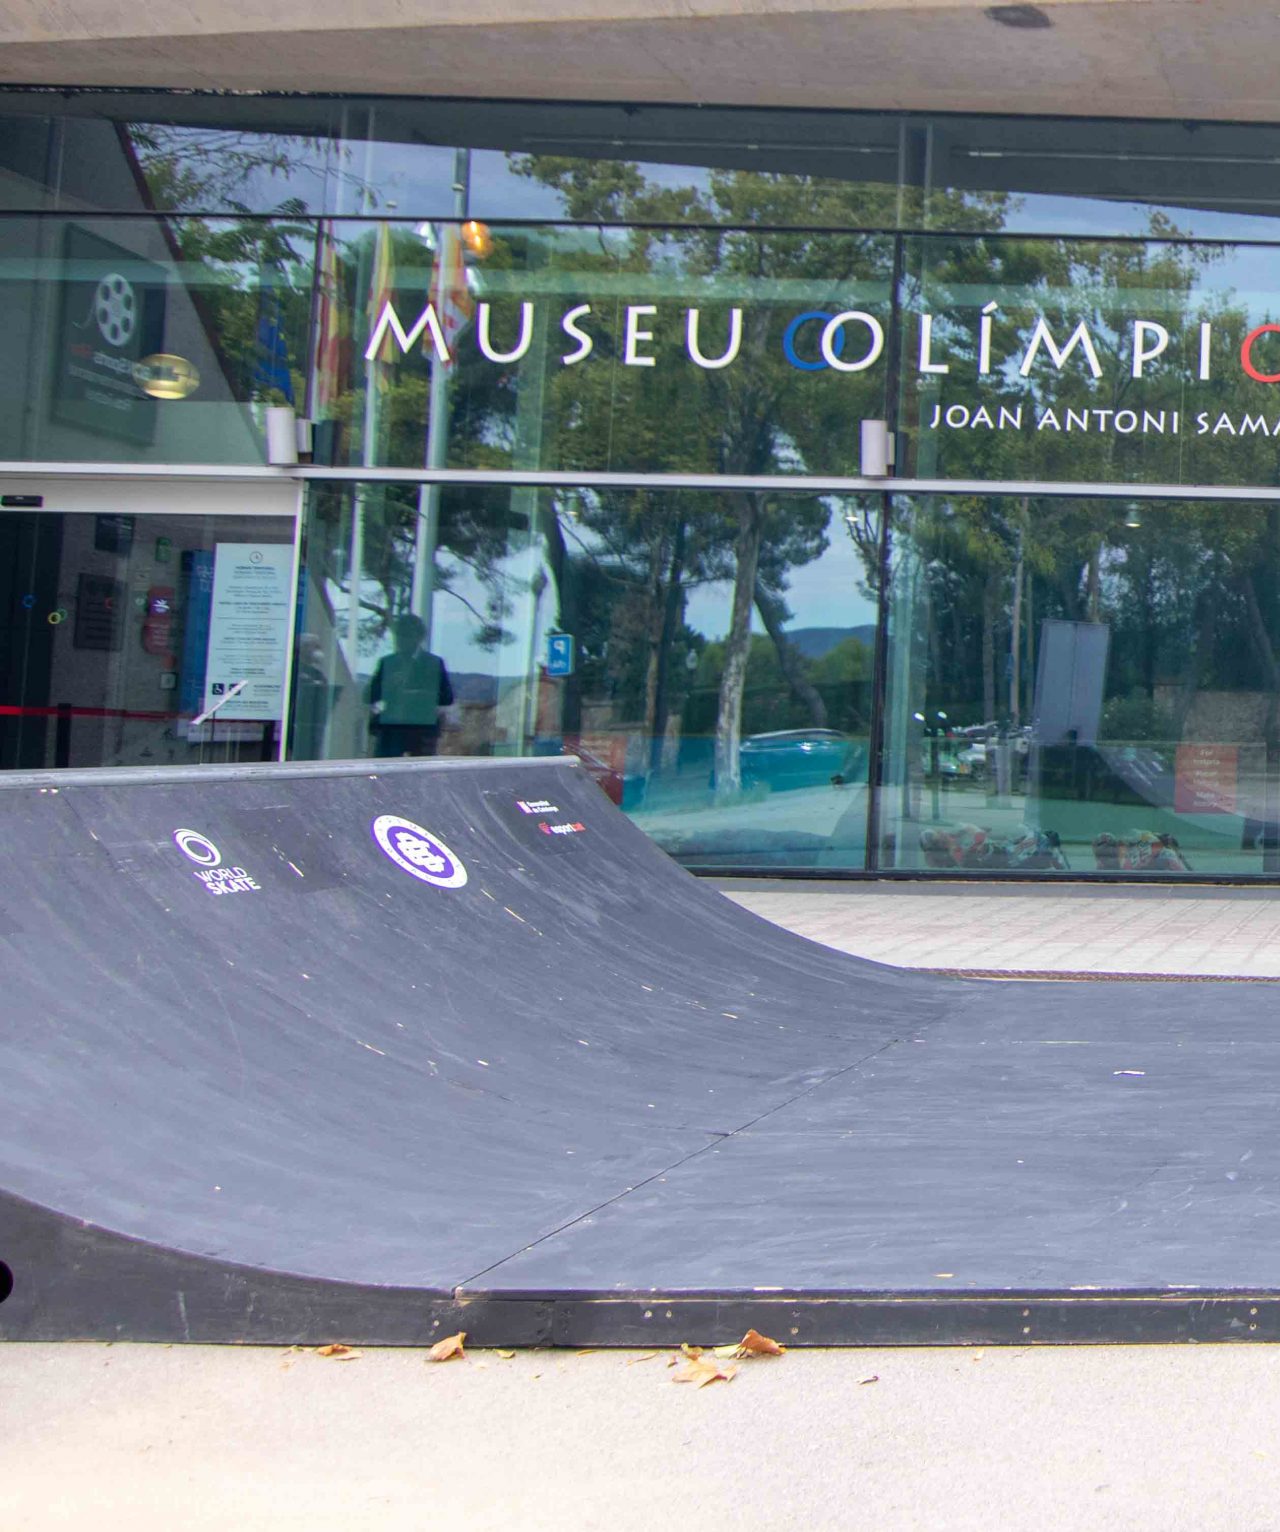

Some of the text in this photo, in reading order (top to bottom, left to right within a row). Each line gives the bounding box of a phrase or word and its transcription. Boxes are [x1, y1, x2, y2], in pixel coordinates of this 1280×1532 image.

[364, 300, 743, 369] MUSEU
[929, 403, 1023, 430] JOAN
[1036, 408, 1180, 435] ANTONI
[193, 866, 248, 882] WORLD
[206, 877, 262, 895] SKATE
